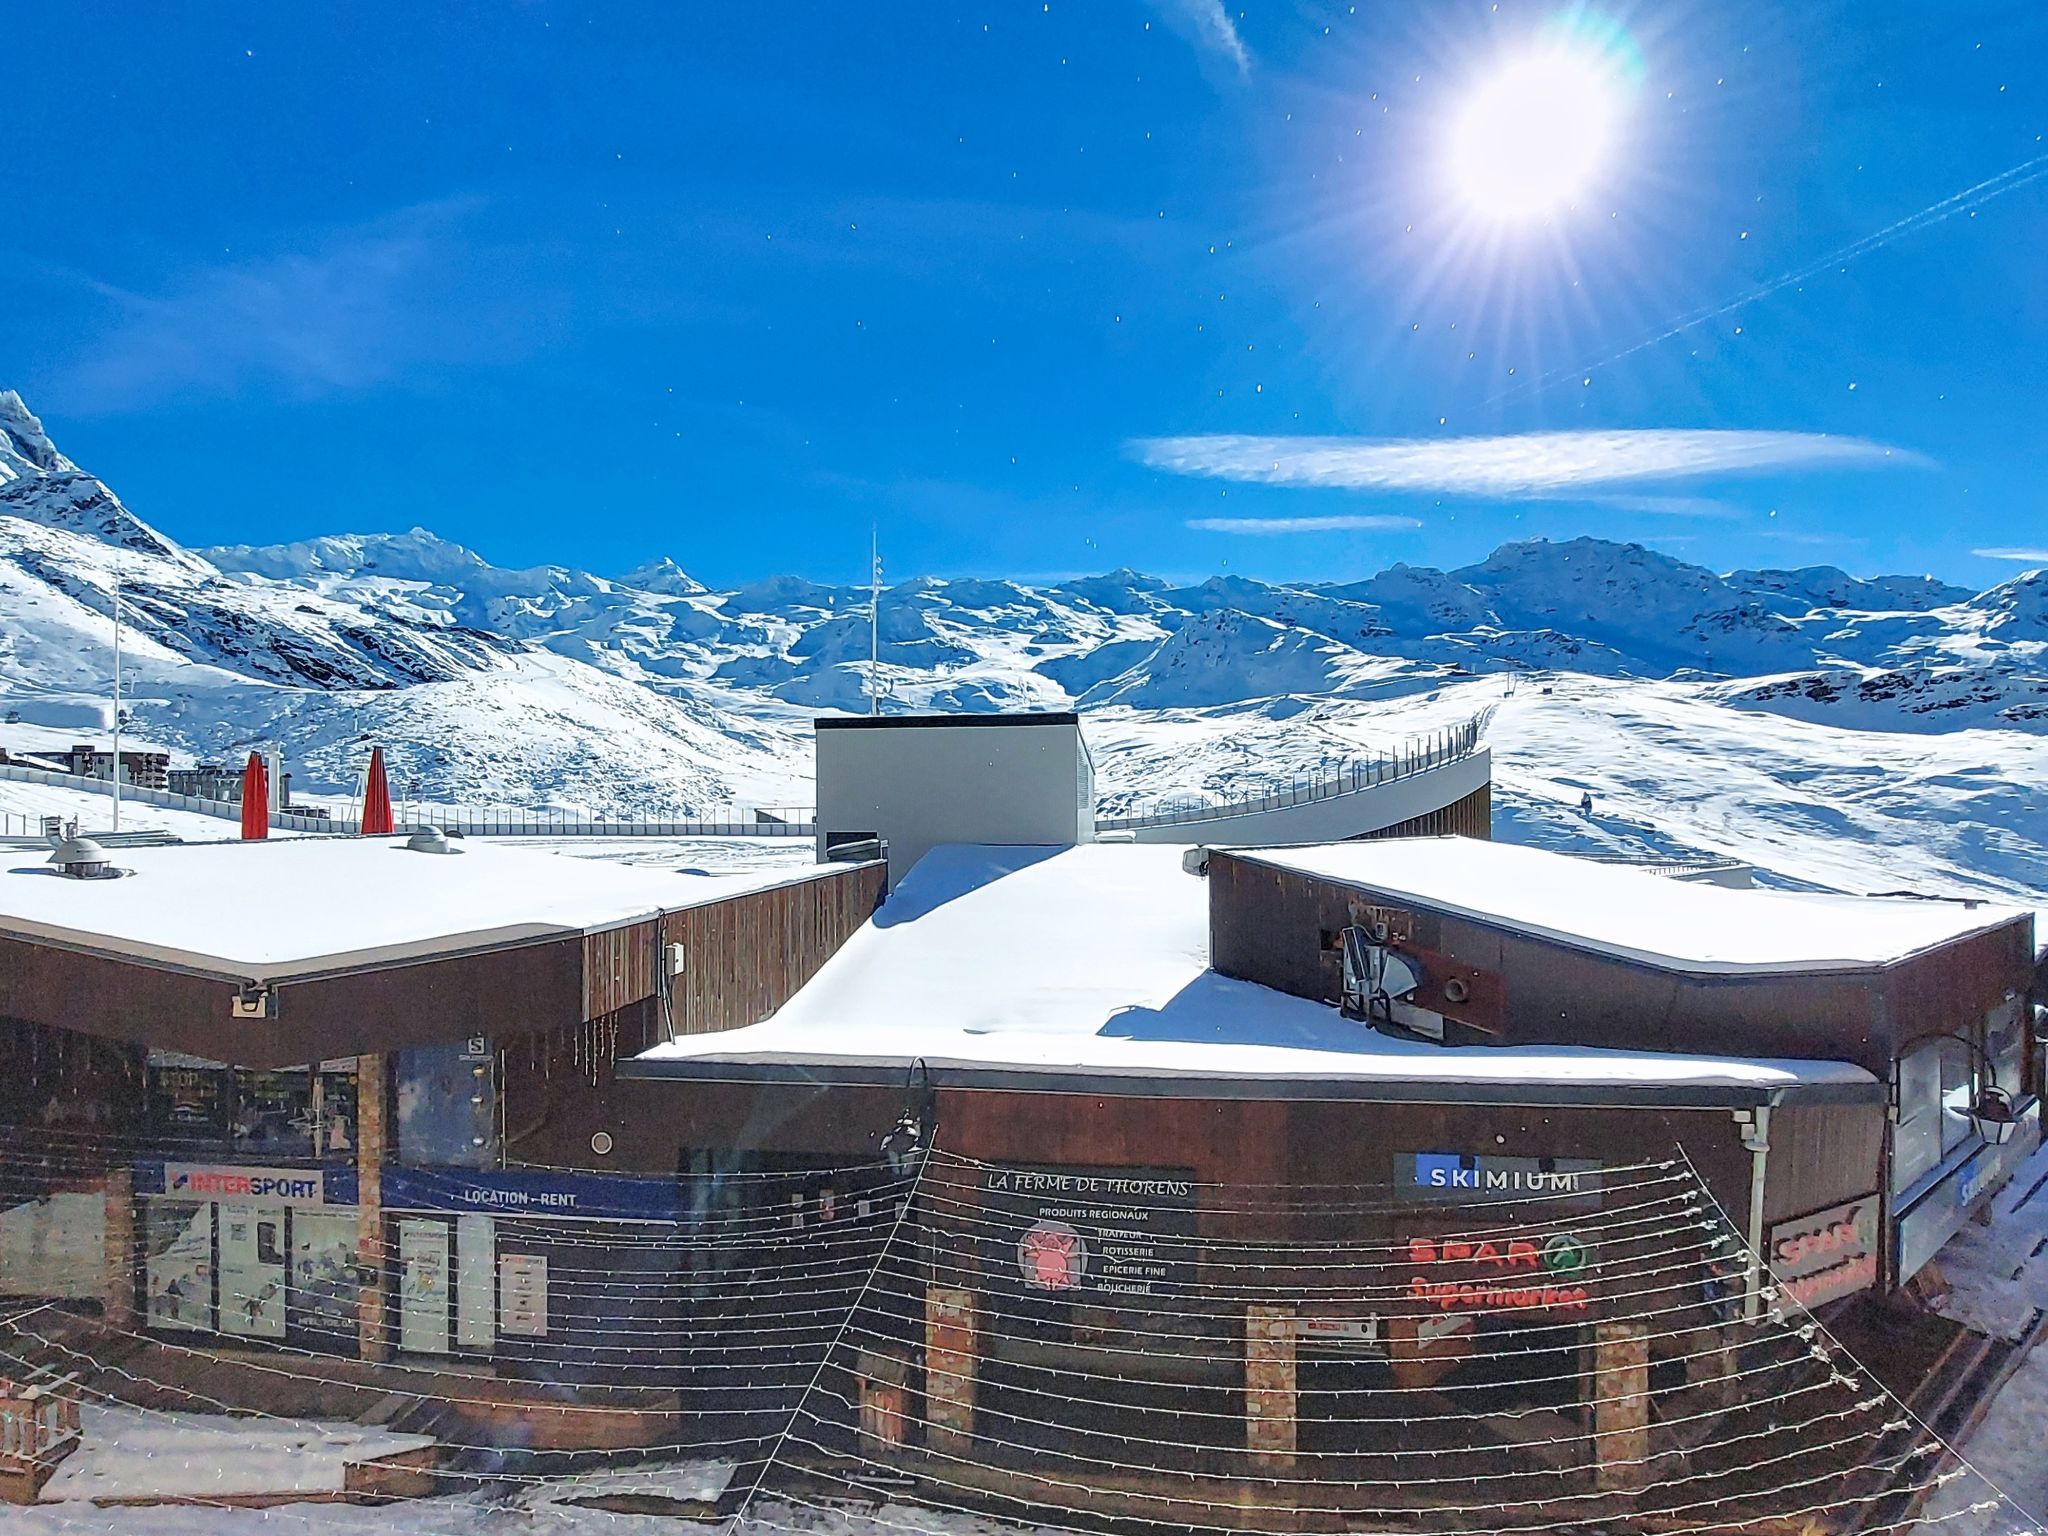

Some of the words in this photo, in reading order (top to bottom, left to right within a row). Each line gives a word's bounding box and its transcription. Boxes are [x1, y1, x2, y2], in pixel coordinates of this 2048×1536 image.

[190, 1172, 317, 1198] INTERSPORT
[987, 1173, 1009, 1190] LA
[1014, 1175, 1071, 1192] FERME
[1077, 1178, 1099, 1192] DE
[1430, 1169, 1571, 1192] SKIMIUM
[464, 1189, 528, 1205] LOCATION
[541, 1193, 577, 1207] RENT
[1039, 1207, 1087, 1219] PRODUITS
[1089, 1209, 1149, 1221] REGIONAUX
[1102, 1246, 1154, 1257] ROTISSERIE
[1408, 1237, 1538, 1268] SPAR
[1103, 1264, 1143, 1275] EPICERIE
[1144, 1266, 1166, 1277] FINE
[1097, 1282, 1151, 1295] BOUCHERIE
